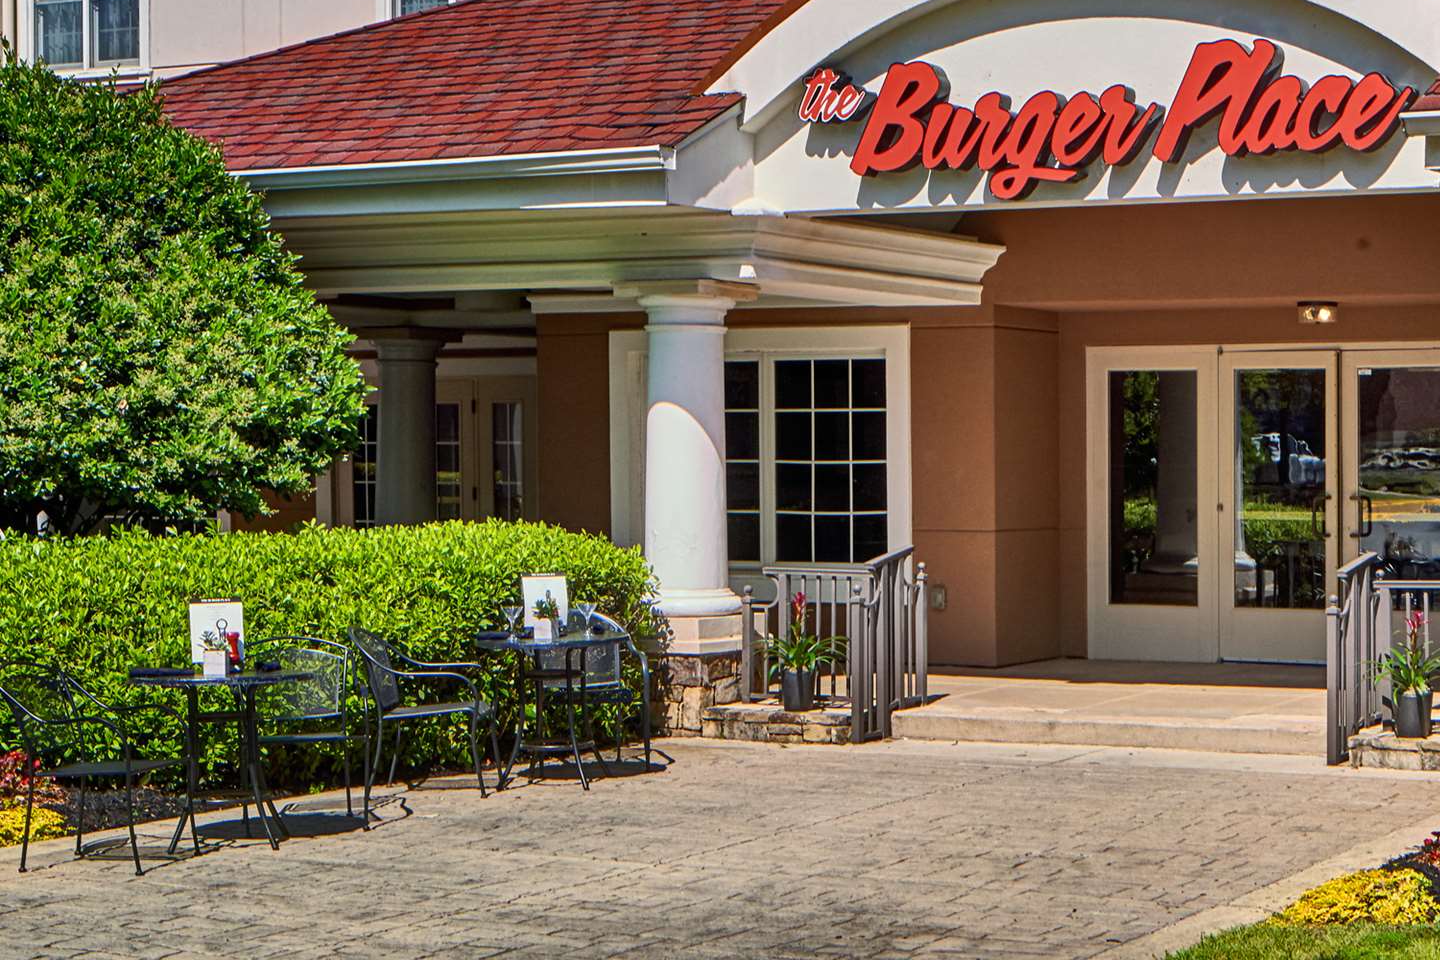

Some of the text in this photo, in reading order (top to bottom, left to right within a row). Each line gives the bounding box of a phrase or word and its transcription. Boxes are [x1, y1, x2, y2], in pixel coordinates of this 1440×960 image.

[799, 38, 1413, 200] the Burger Place
